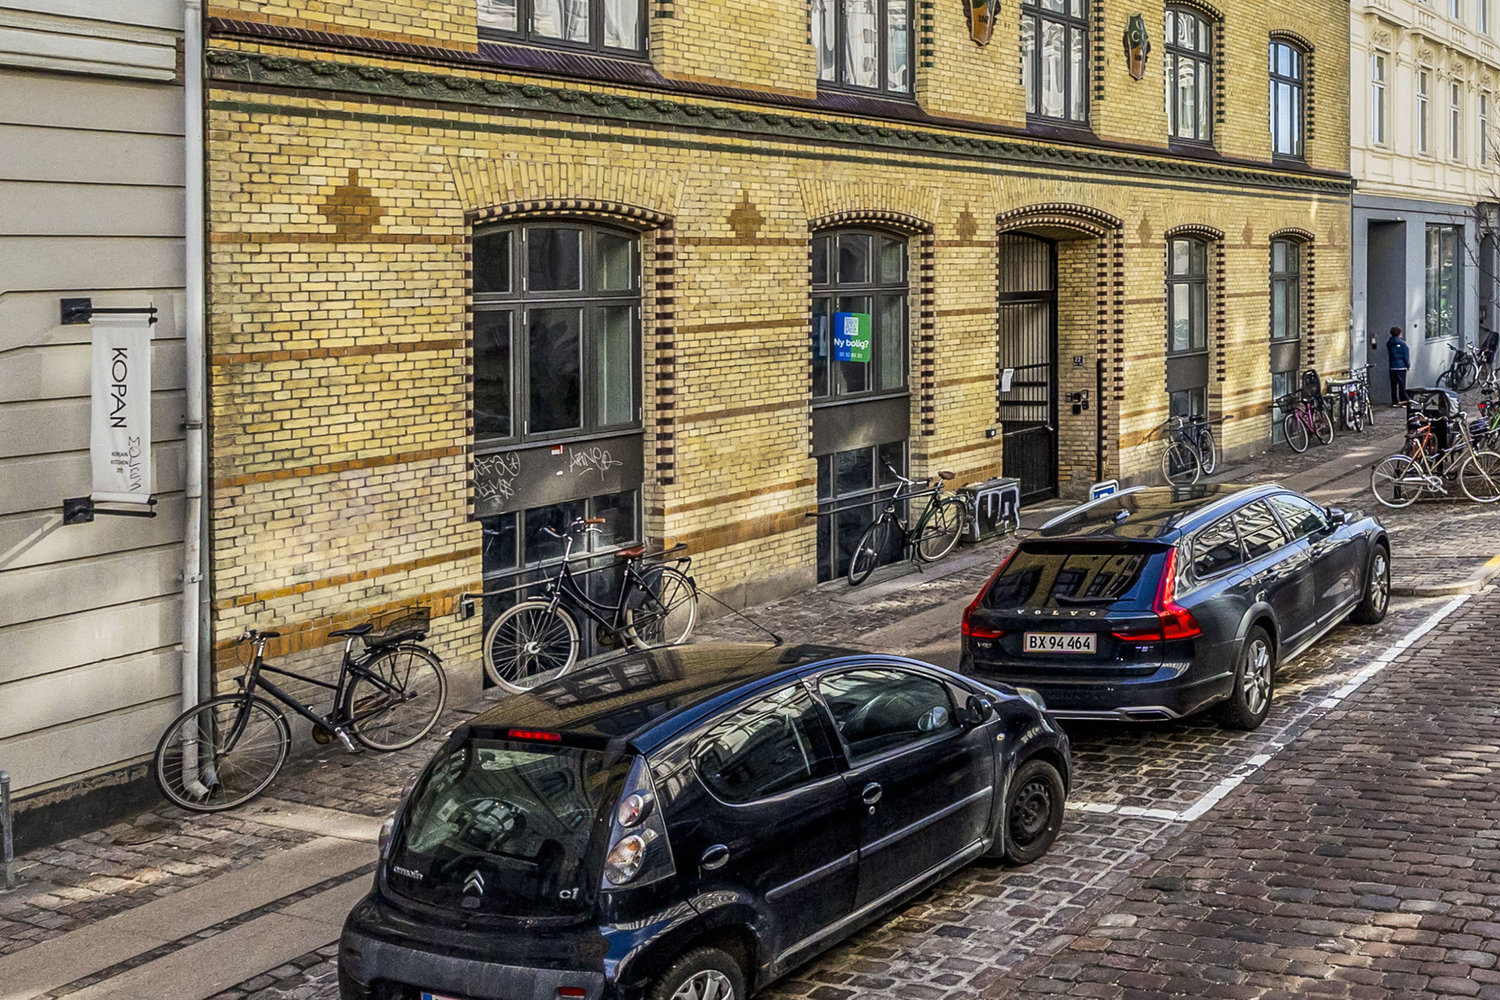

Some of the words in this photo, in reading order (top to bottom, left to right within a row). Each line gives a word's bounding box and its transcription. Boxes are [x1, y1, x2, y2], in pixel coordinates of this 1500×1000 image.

[833, 338, 845, 348] Ny
[845, 339, 869, 350] bolig?
[109, 347, 128, 428] KOPAN
[1016, 609, 1097, 617] VOLVO
[1029, 635, 1046, 649] BX
[1049, 636, 1065, 649] 94
[1067, 636, 1091, 650] 464
